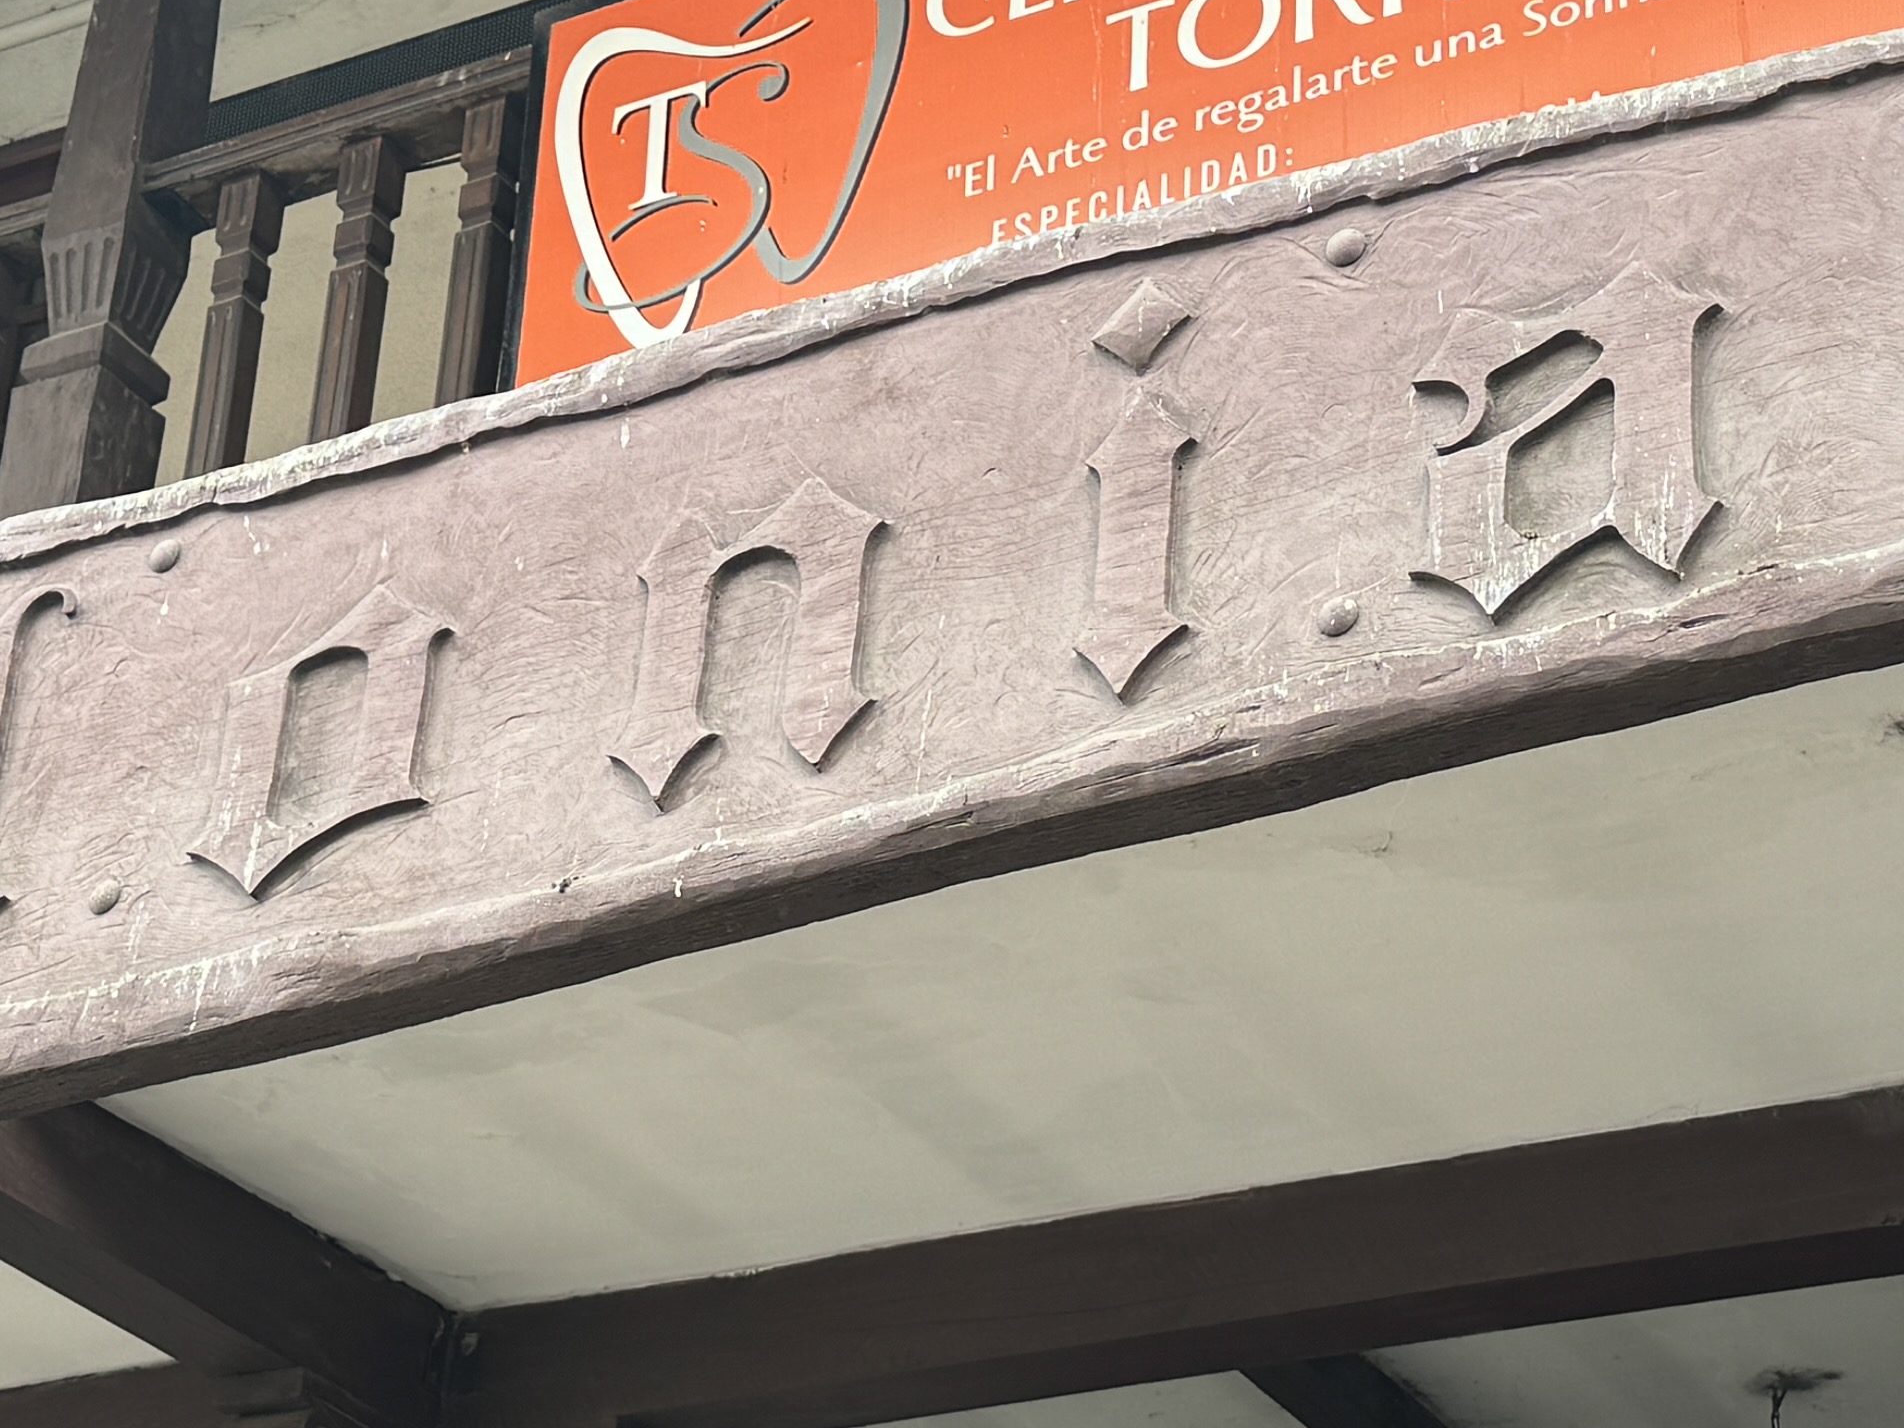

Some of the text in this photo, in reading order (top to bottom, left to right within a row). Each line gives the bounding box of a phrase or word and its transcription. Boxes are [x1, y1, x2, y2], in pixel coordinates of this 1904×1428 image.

[948, 154, 996, 198] "El
[1010, 135, 1108, 184] Arte
[1122, 109, 1179, 152] de
[1195, 54, 1399, 134] regalarte
[1415, 22, 1506, 68] una
[992, 149, 1295, 248] ESPECIALIDAD:
